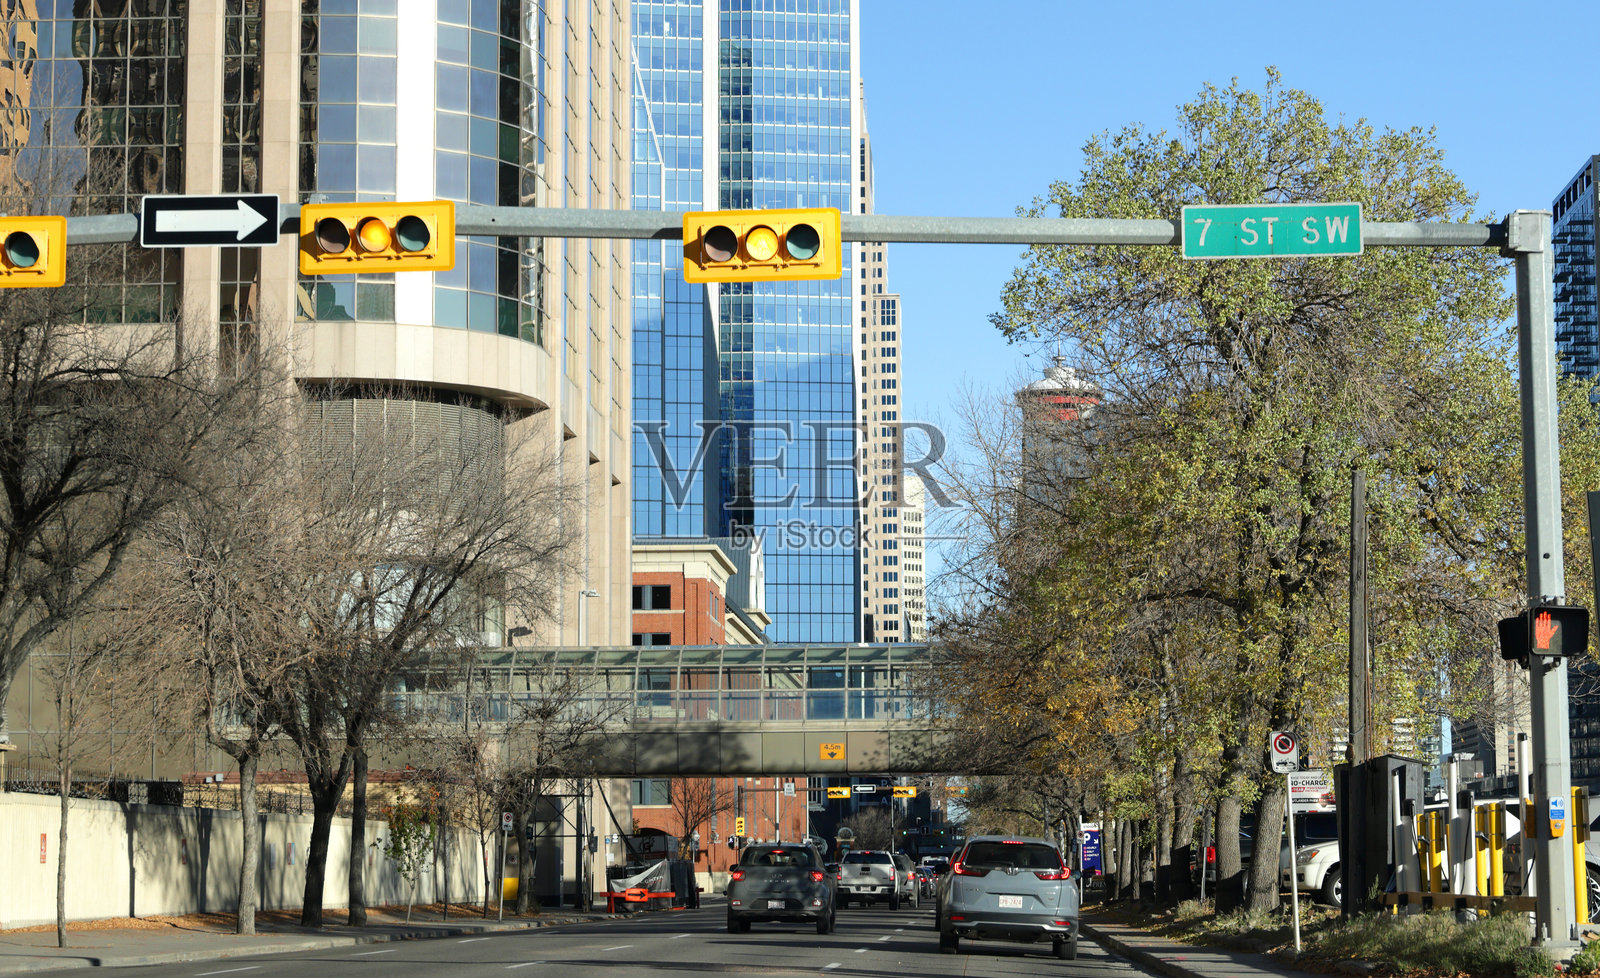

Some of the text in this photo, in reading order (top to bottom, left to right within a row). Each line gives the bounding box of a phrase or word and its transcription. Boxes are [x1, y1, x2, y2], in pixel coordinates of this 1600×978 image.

[1194, 215, 1350, 247] 7 ST SW
